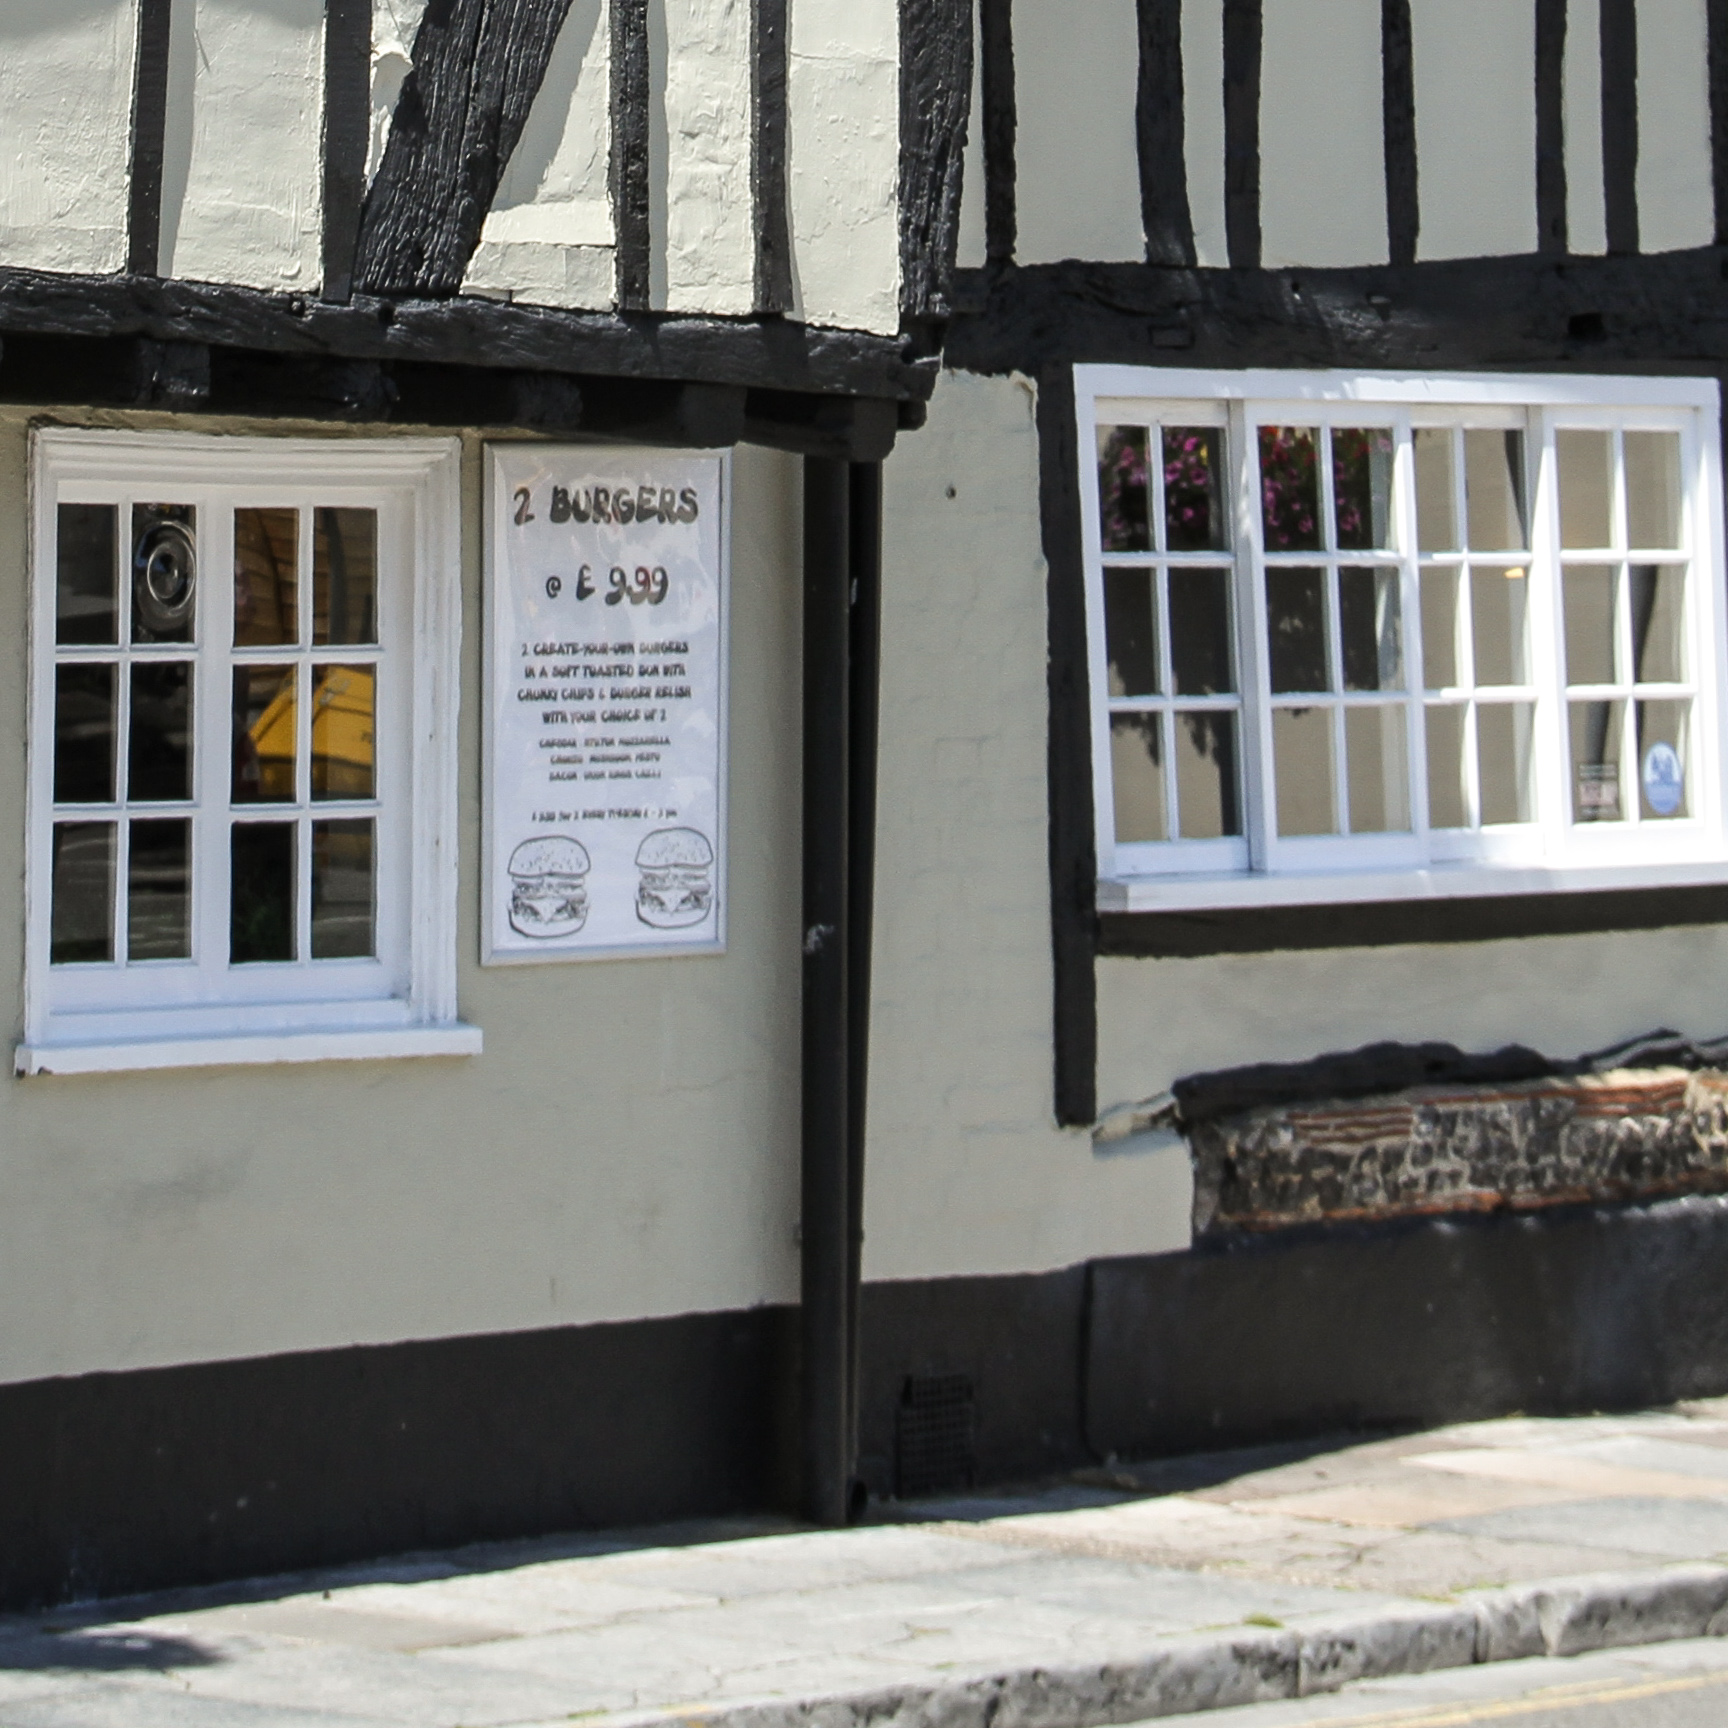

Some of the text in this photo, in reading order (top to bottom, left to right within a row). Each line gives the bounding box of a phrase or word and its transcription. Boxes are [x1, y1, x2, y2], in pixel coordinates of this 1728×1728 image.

[514, 485, 698, 526] 2 BURGERS
[546, 576, 561, 598] @
[639, 641, 689, 654] BURGERS
[539, 665, 548, 678] A
[552, 664, 580, 678] SOFT
[583, 664, 634, 678] TOASTED
